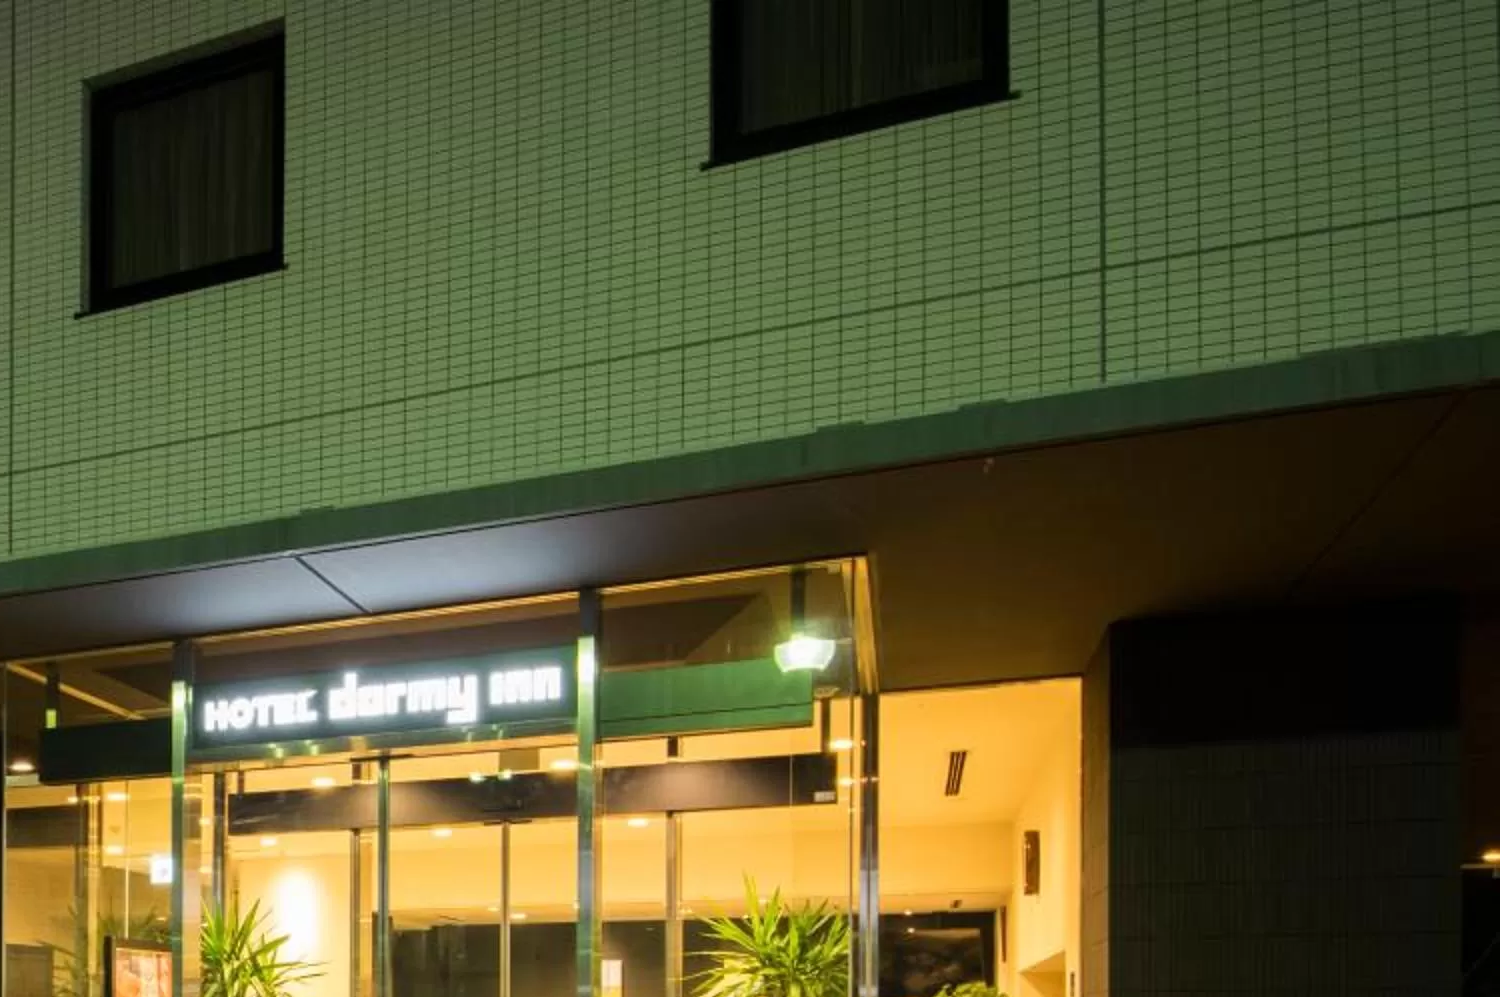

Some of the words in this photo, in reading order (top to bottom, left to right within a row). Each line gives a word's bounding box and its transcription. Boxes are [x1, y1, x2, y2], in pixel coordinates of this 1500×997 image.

[204, 689, 318, 732] HOTEL
[327, 671, 479, 725] dormy
[488, 665, 562, 706] inn
